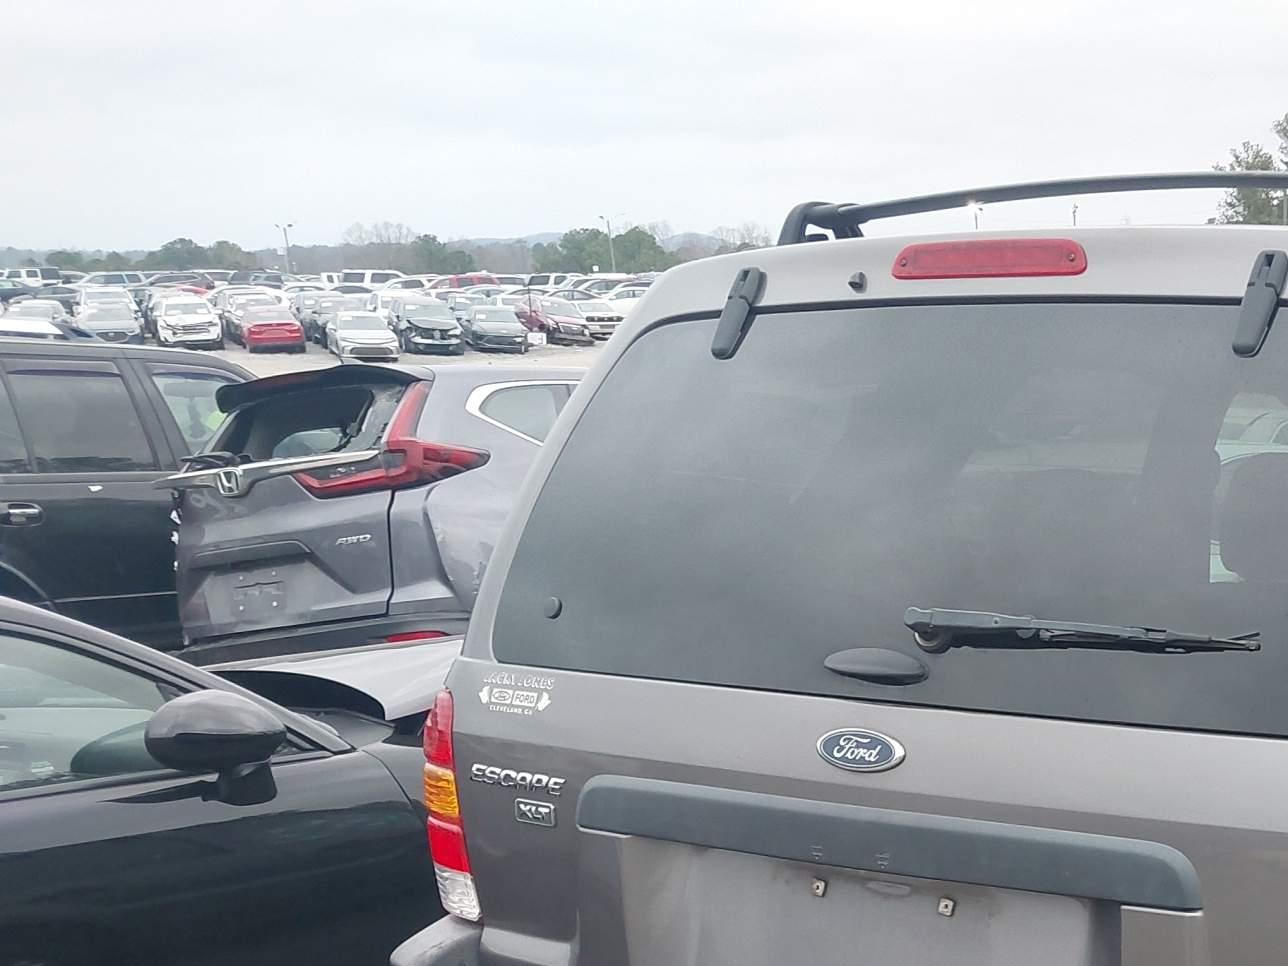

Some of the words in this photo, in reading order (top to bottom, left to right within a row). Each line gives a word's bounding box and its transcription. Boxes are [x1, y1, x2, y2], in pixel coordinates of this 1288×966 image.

[335, 533, 372, 545] AWD
[515, 693, 535, 704] FORD
[833, 734, 882, 762] Ford
[470, 762, 567, 796] ESCAPE
[518, 802, 551, 821] XLT
